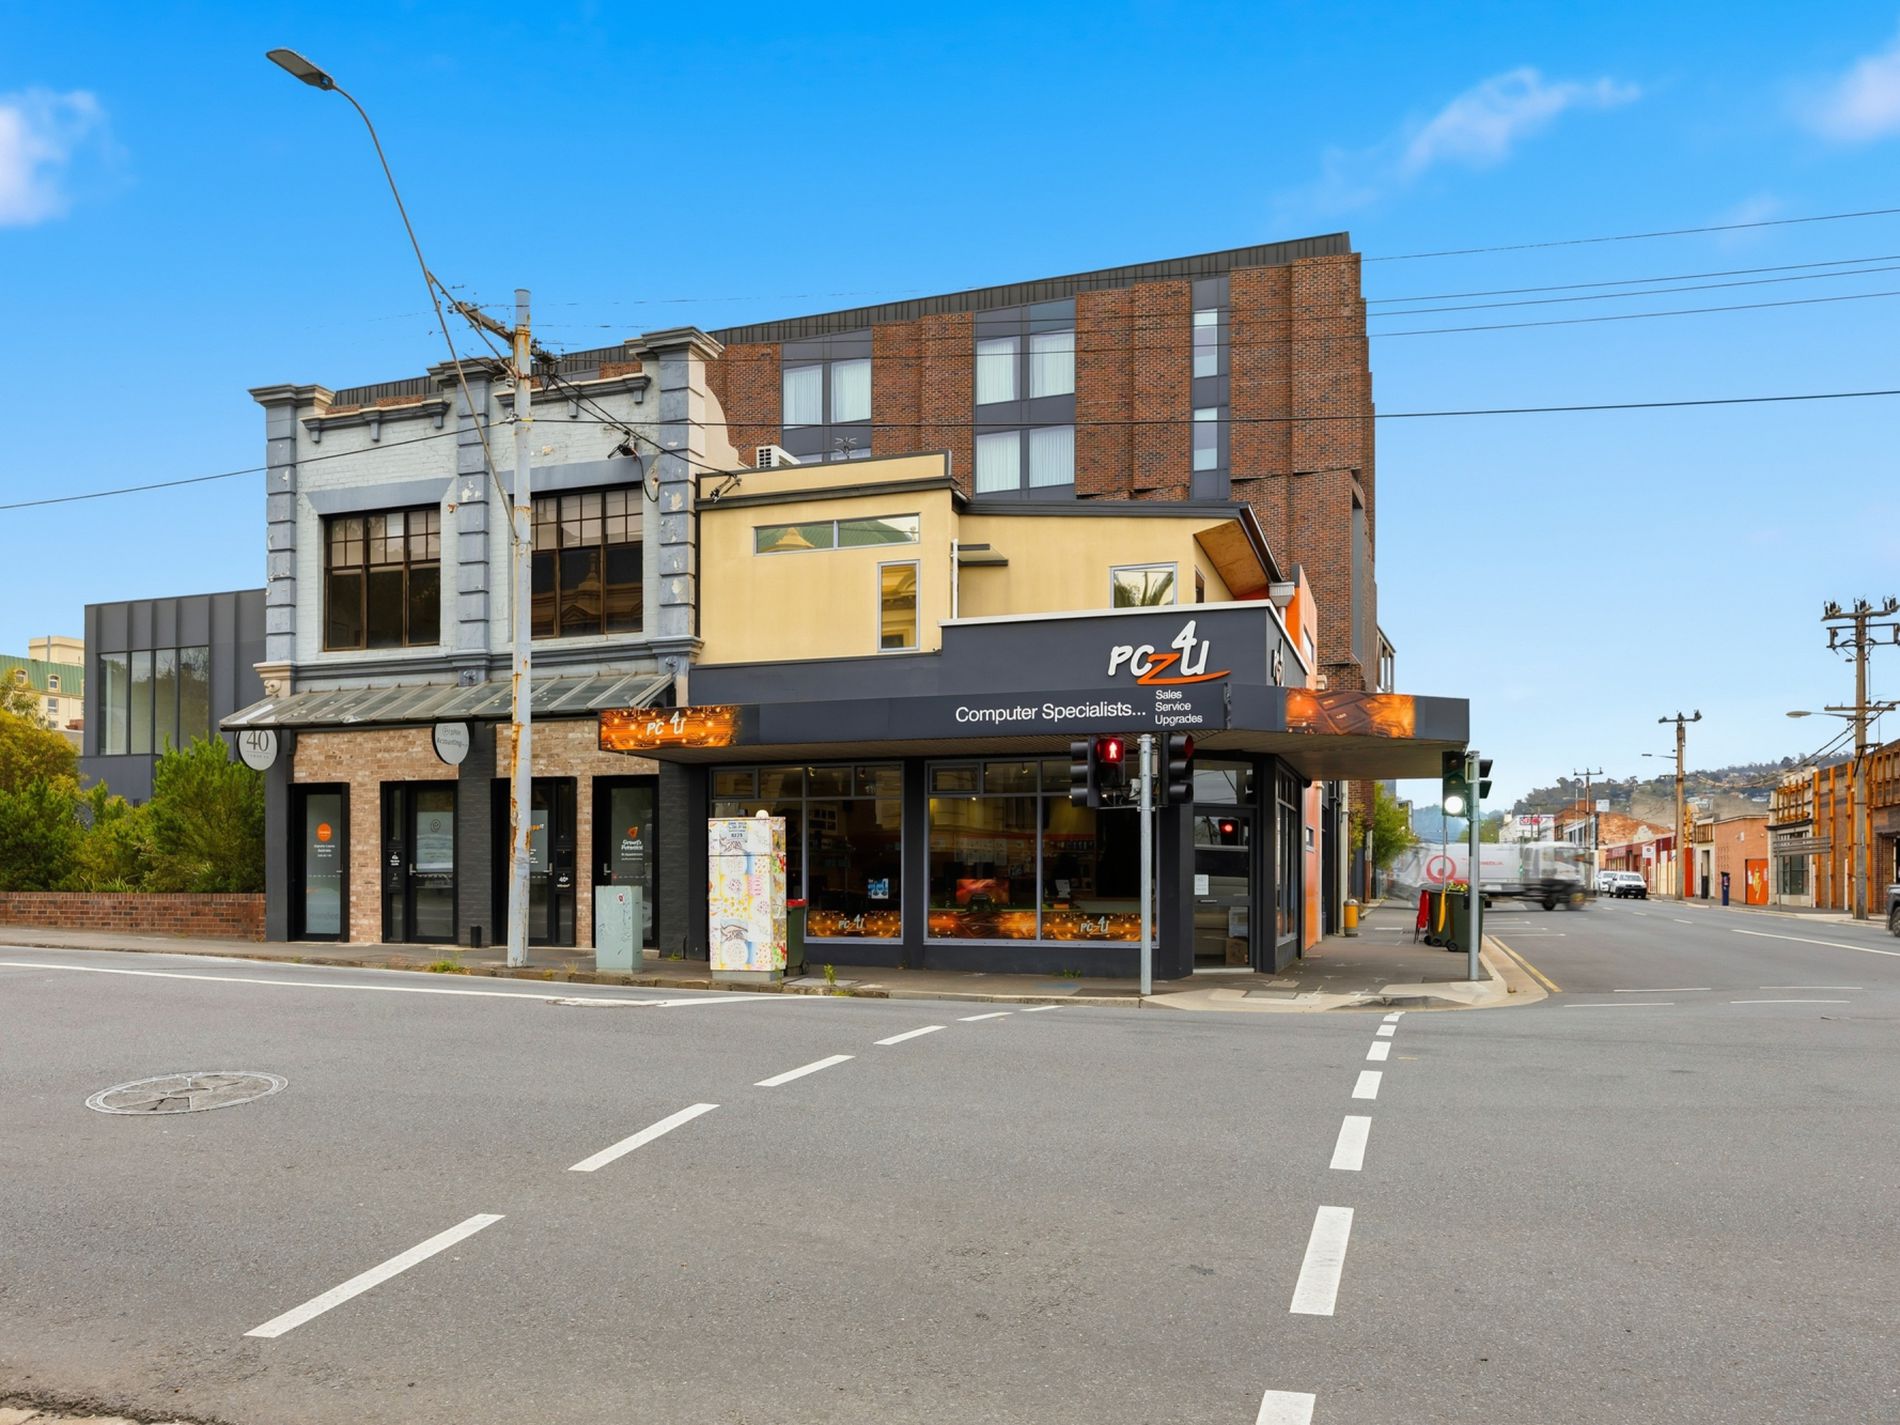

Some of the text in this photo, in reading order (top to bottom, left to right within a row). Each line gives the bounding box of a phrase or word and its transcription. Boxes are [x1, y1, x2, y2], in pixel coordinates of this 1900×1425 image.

[1155, 689, 1183, 700] Sales
[955, 701, 1147, 725] Computer Specialists...
[1155, 702, 1192, 712] Service
[1155, 713, 1203, 726] Upgrades
[246, 730, 269, 752] 40
